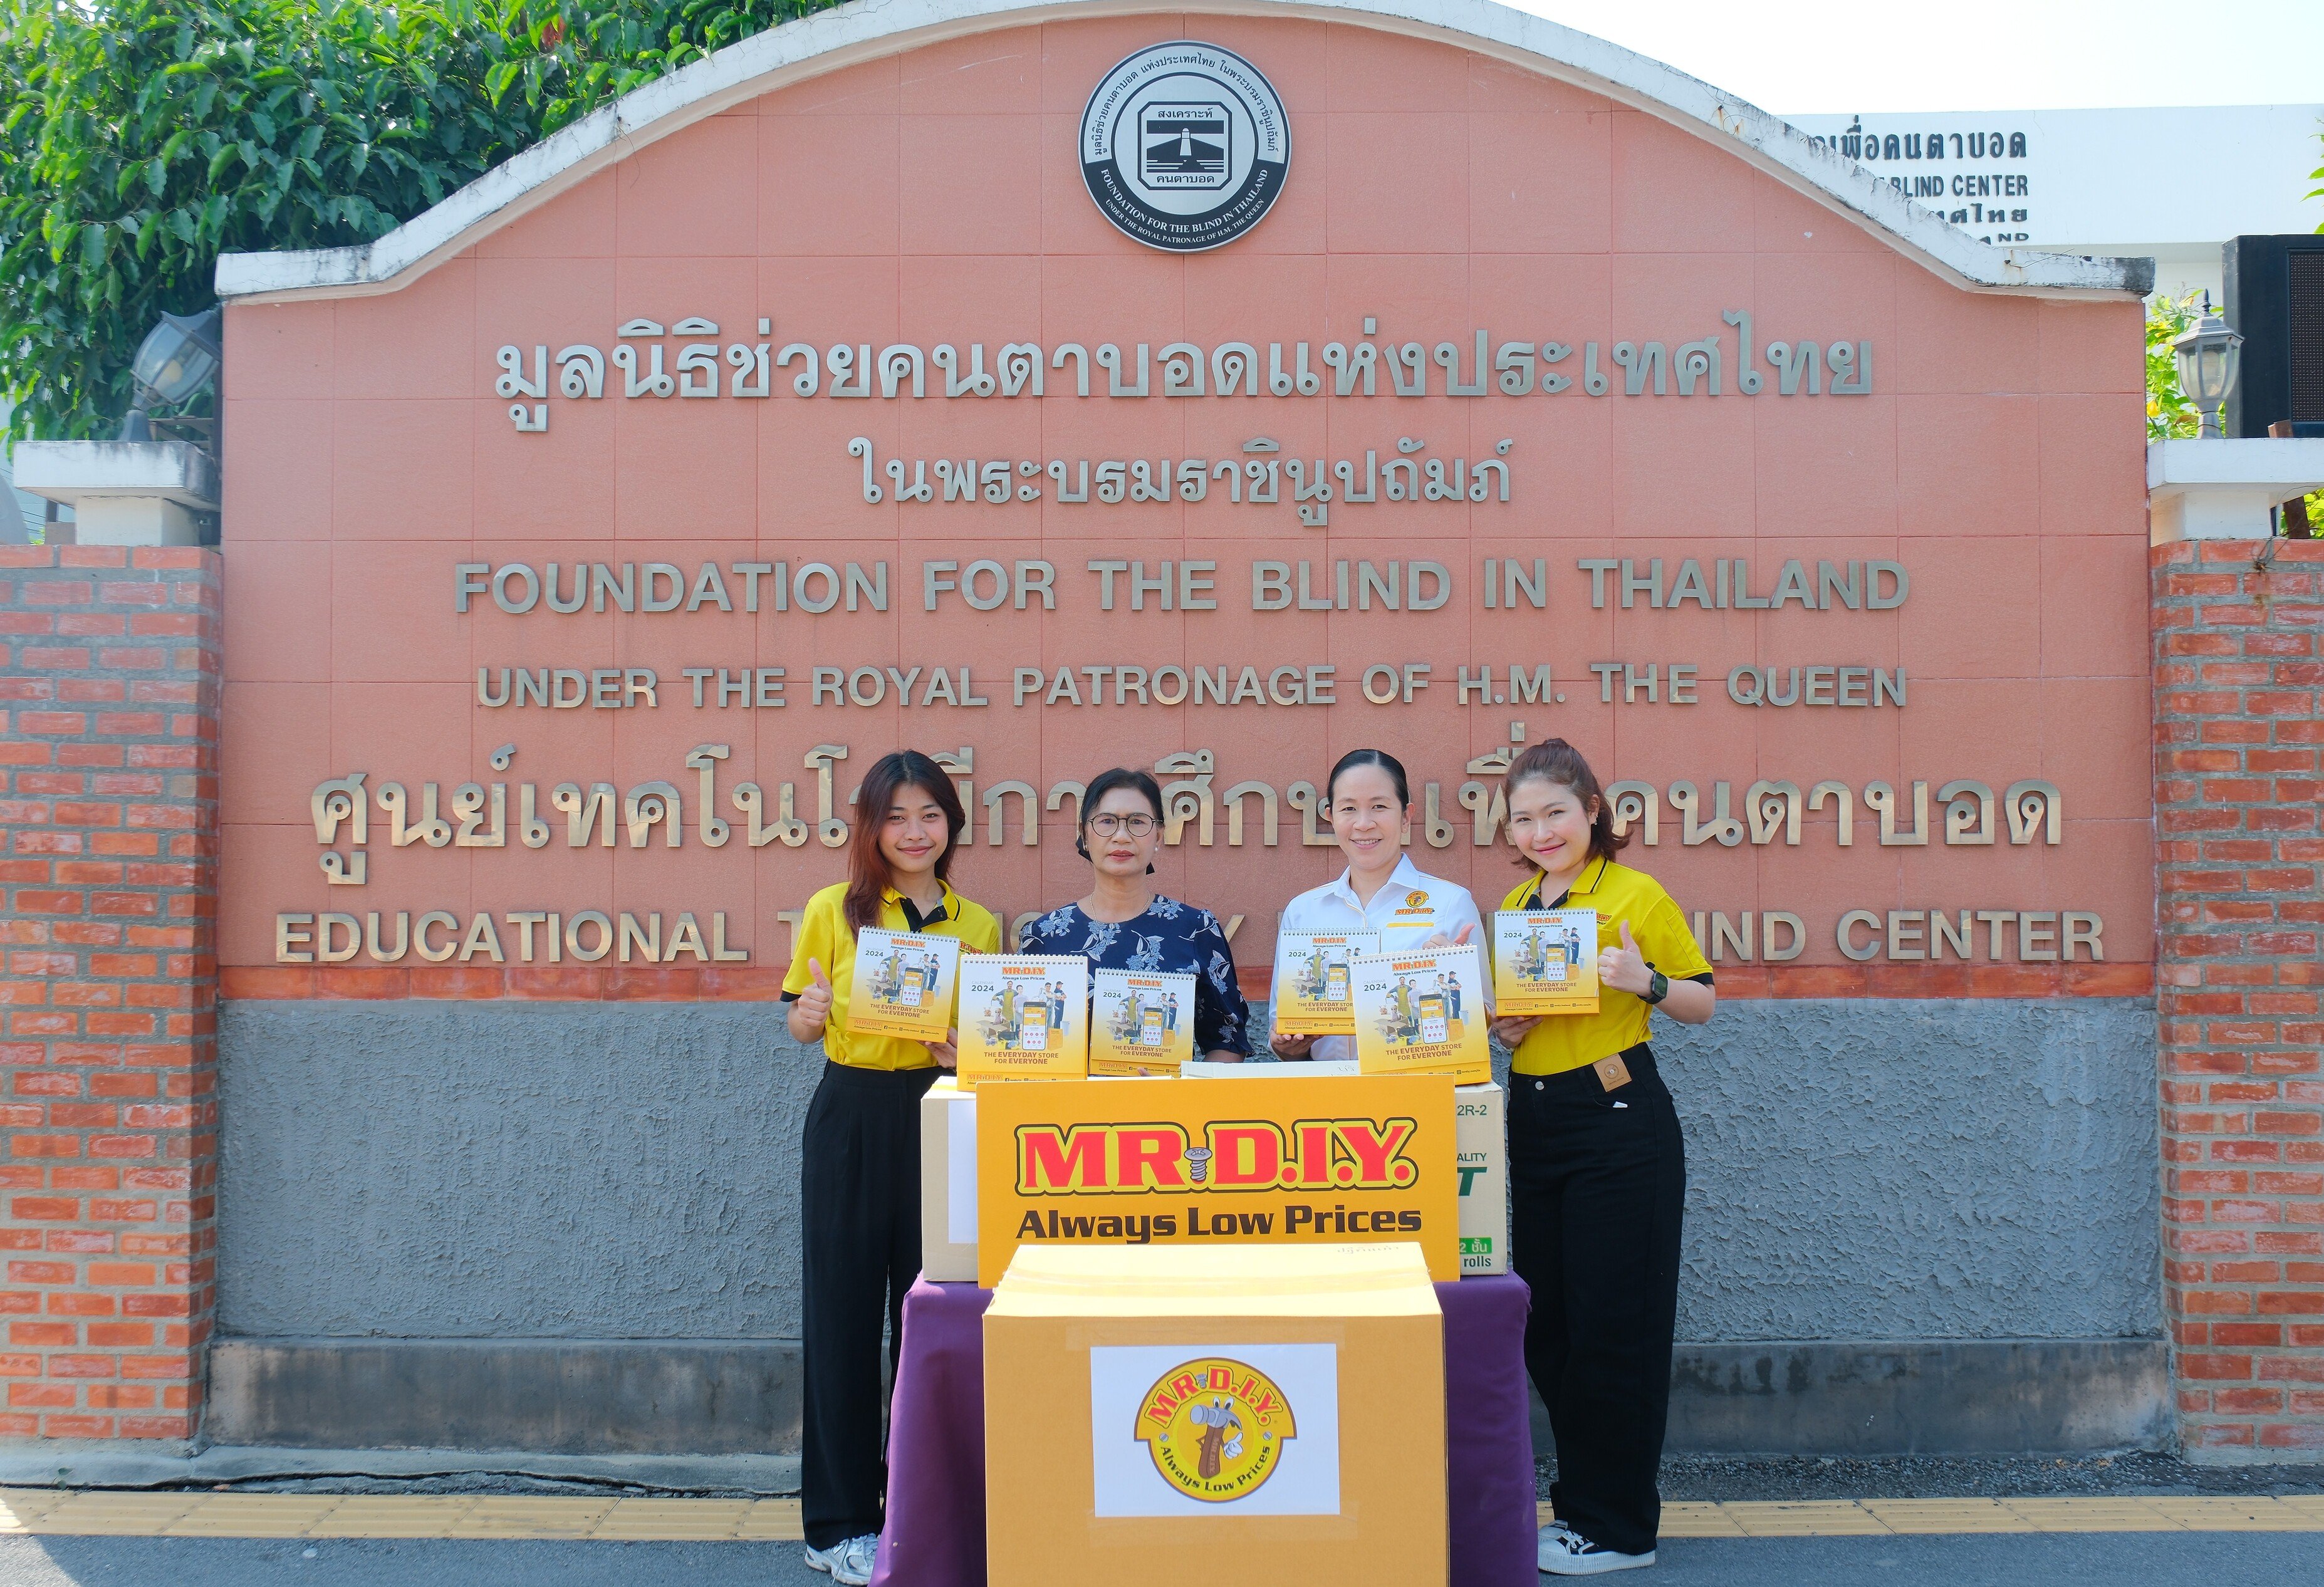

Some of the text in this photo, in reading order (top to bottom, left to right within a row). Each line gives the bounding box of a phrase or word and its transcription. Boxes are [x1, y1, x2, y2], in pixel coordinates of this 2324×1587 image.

[1091, 71, 1139, 155] มูลนิธิช่วยคนตาบอด
[1219, 60, 1279, 152] ในพระบรมราชินูปถัมภ์
[1157, 175, 1215, 184] คนตาบอด
[1952, 174, 2029, 197] CENTER
[1101, 168, 1269, 233] FOUNDATION FOR THE BLIND IN THAILAND
[1105, 199, 1125, 220] UNDER
[1124, 217, 1137, 230] THE
[1137, 226, 1161, 241] ROYAL
[1162, 234, 1207, 244] PATRONAGE
[1217, 226, 1232, 237] H.M.
[1232, 217, 1247, 229] THE
[1245, 198, 1265, 220] QUEEN
[495, 308, 1872, 432] มูลนิธิช่วยคนตาบอดแห่งประเทศไทย
[848, 437, 1513, 528] ในพระบรมราชินูปถัมภ์
[455, 558, 1910, 614] FOUNDATION FOR THE BLIND IN THAILAND
[477, 663, 1907, 709] UNDER THE ROYAL PATRONAGE OF H.M. THE QUEEN
[276, 910, 748, 964] EDUCATIONAL
[1837, 909, 2105, 962] CENTER
[1363, 983, 1387, 991] 2024
[881, 1004, 913, 1012] EVERYDAY
[889, 1010, 921, 1018] EVERYONE
[1400, 1045, 1440, 1054] EVERYDAY
[1412, 1051, 1452, 1059] EVERYONE
[1456, 1153, 1488, 1162] ALITY
[1015, 1204, 1422, 1244] Always Low Prices
[1471, 1237, 1488, 1252] ชั้น
[1464, 1256, 1492, 1267] rolls
[1160, 1445, 1271, 1492] Always Low Prices
